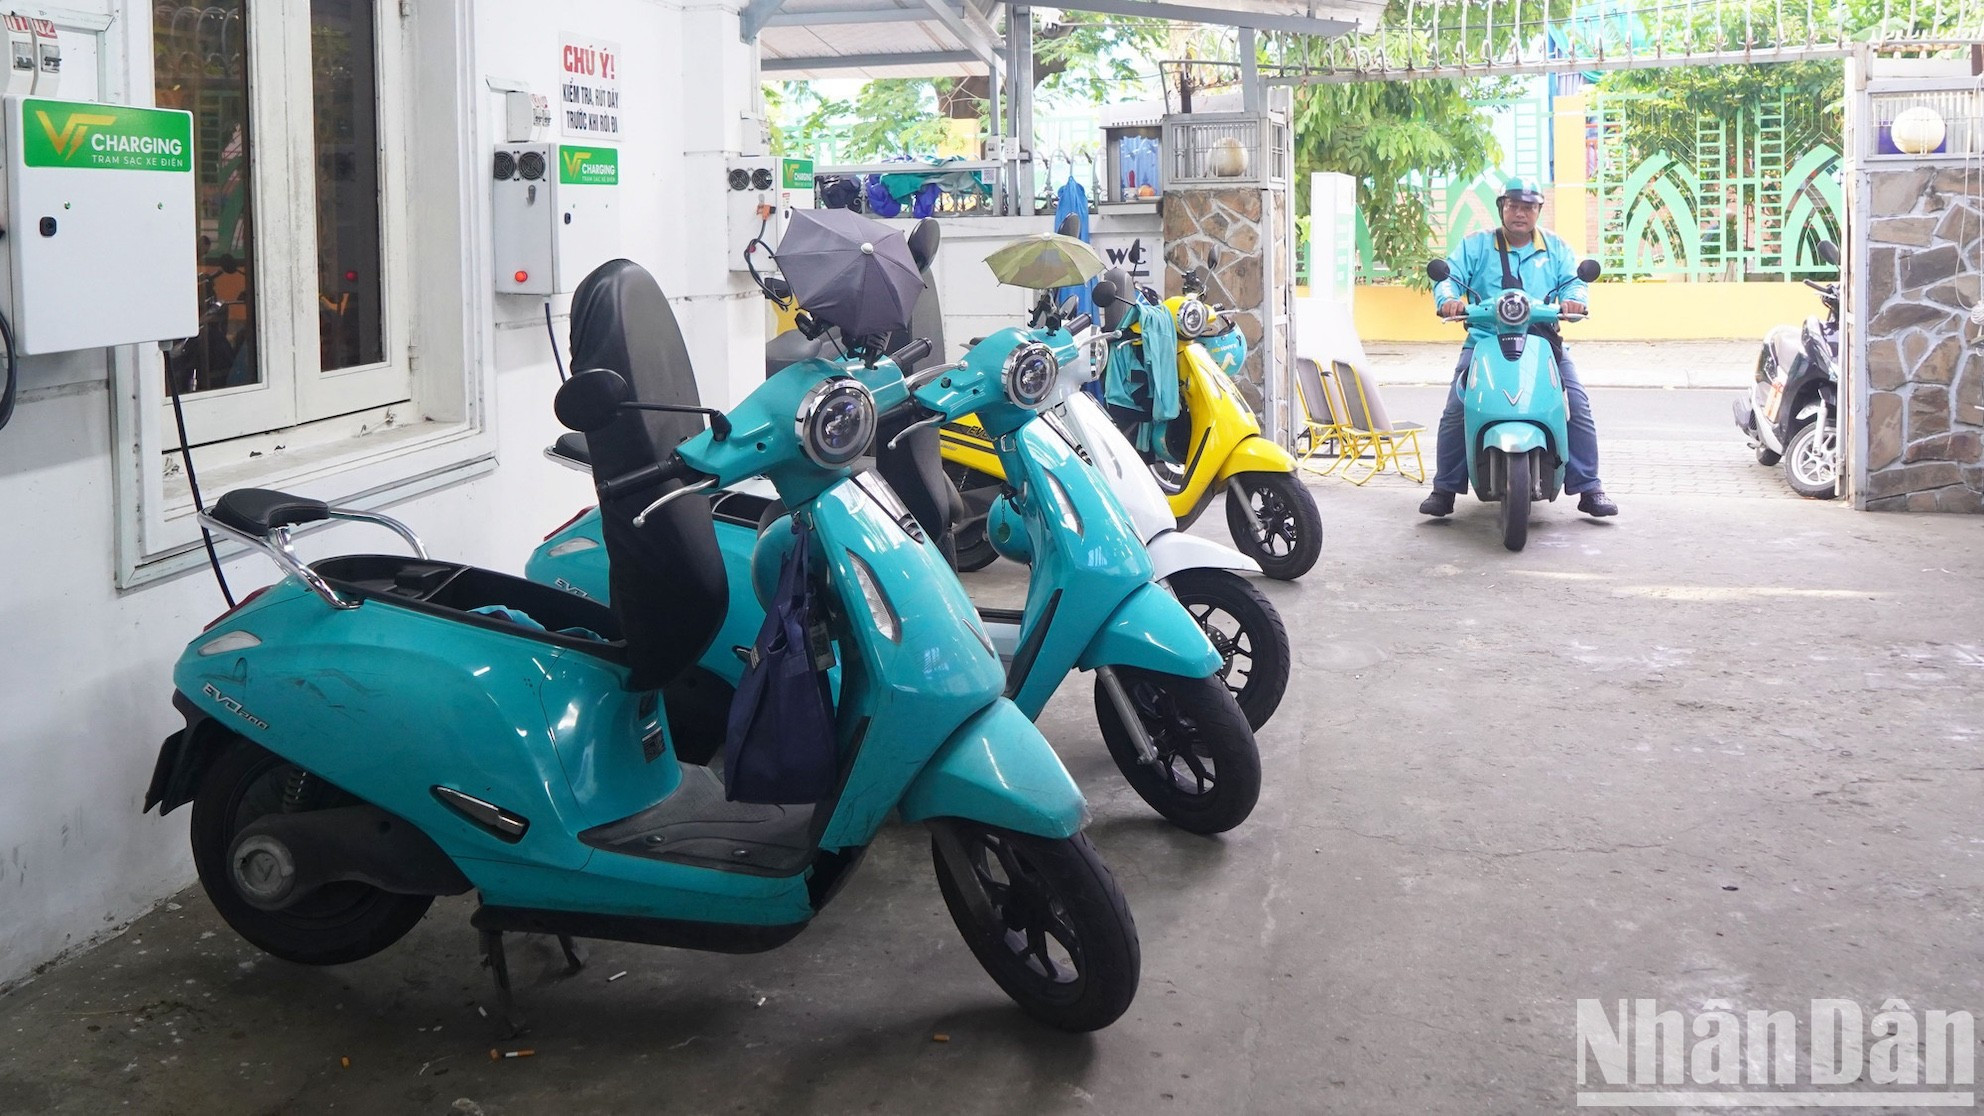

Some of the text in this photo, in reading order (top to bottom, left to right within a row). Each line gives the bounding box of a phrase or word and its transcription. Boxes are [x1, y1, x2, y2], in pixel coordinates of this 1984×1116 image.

[563, 44, 615, 80] CHÚ Ý!
[562, 77, 580, 103] KIỂM
[607, 88, 619, 109] DÂY
[566, 108, 588, 131] TRƯỚC
[588, 113, 599, 132] KHI
[611, 115, 619, 134] ĐI
[91, 133, 183, 155] CHARGING
[145, 157, 158, 166] XE
[581, 163, 615, 175] CHARGING
